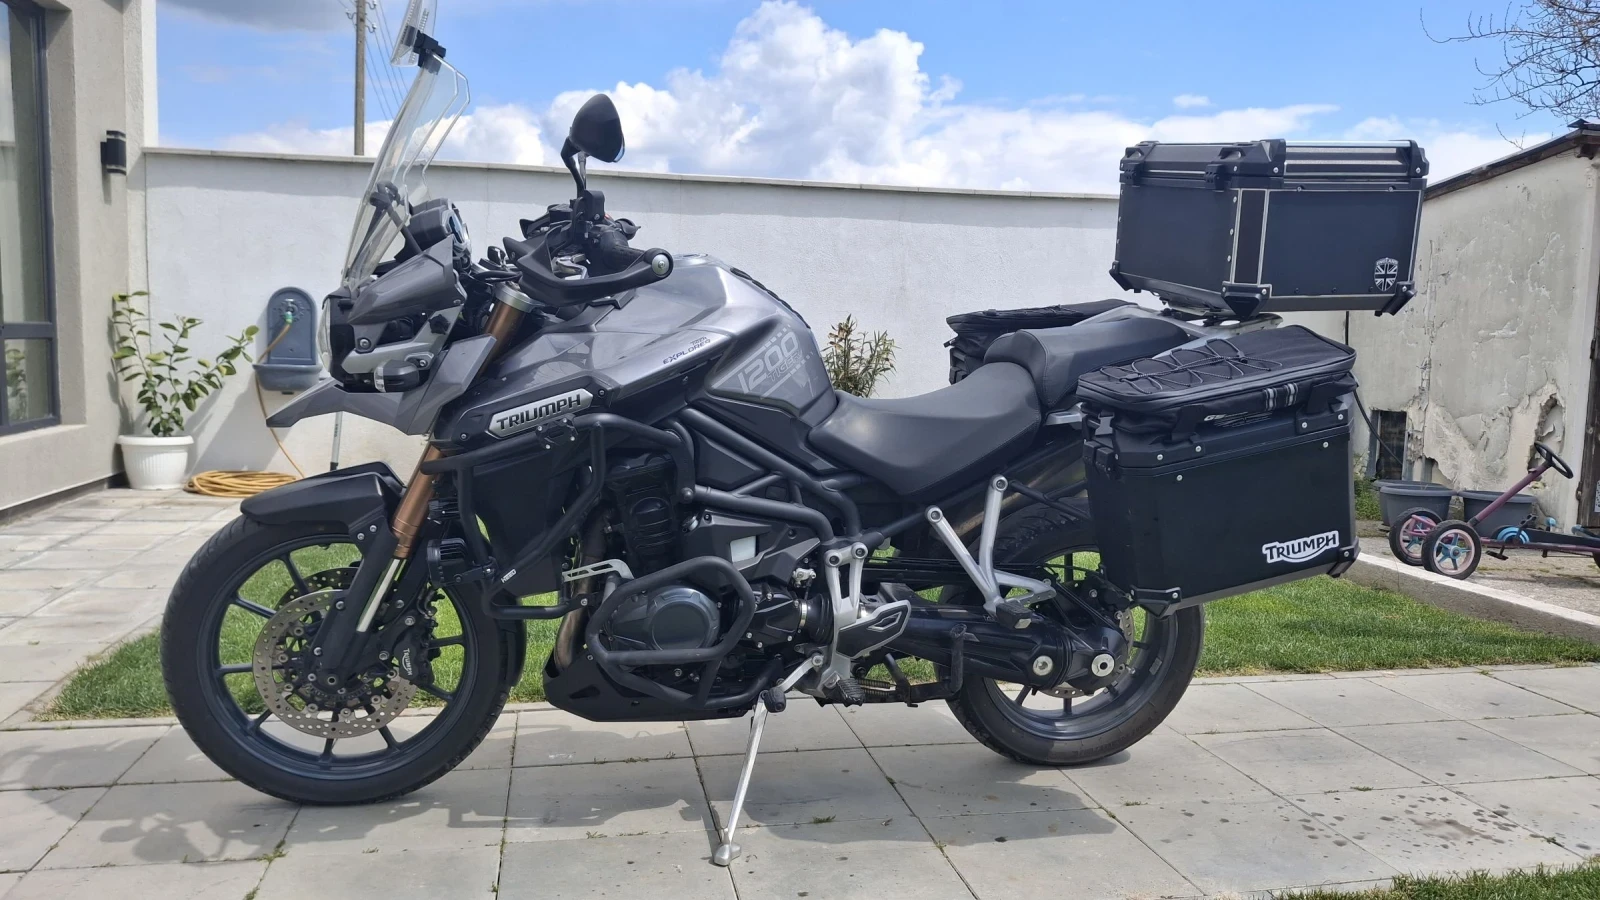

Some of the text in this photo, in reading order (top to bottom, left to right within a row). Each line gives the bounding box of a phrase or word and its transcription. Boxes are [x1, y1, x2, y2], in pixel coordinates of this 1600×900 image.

[662, 339, 711, 365] EXPLORER
[738, 331, 800, 394] 1200
[766, 350, 803, 382] TIGER
[496, 394, 581, 430] TRIUMPH
[1265, 534, 1336, 560] TRIUMPH
